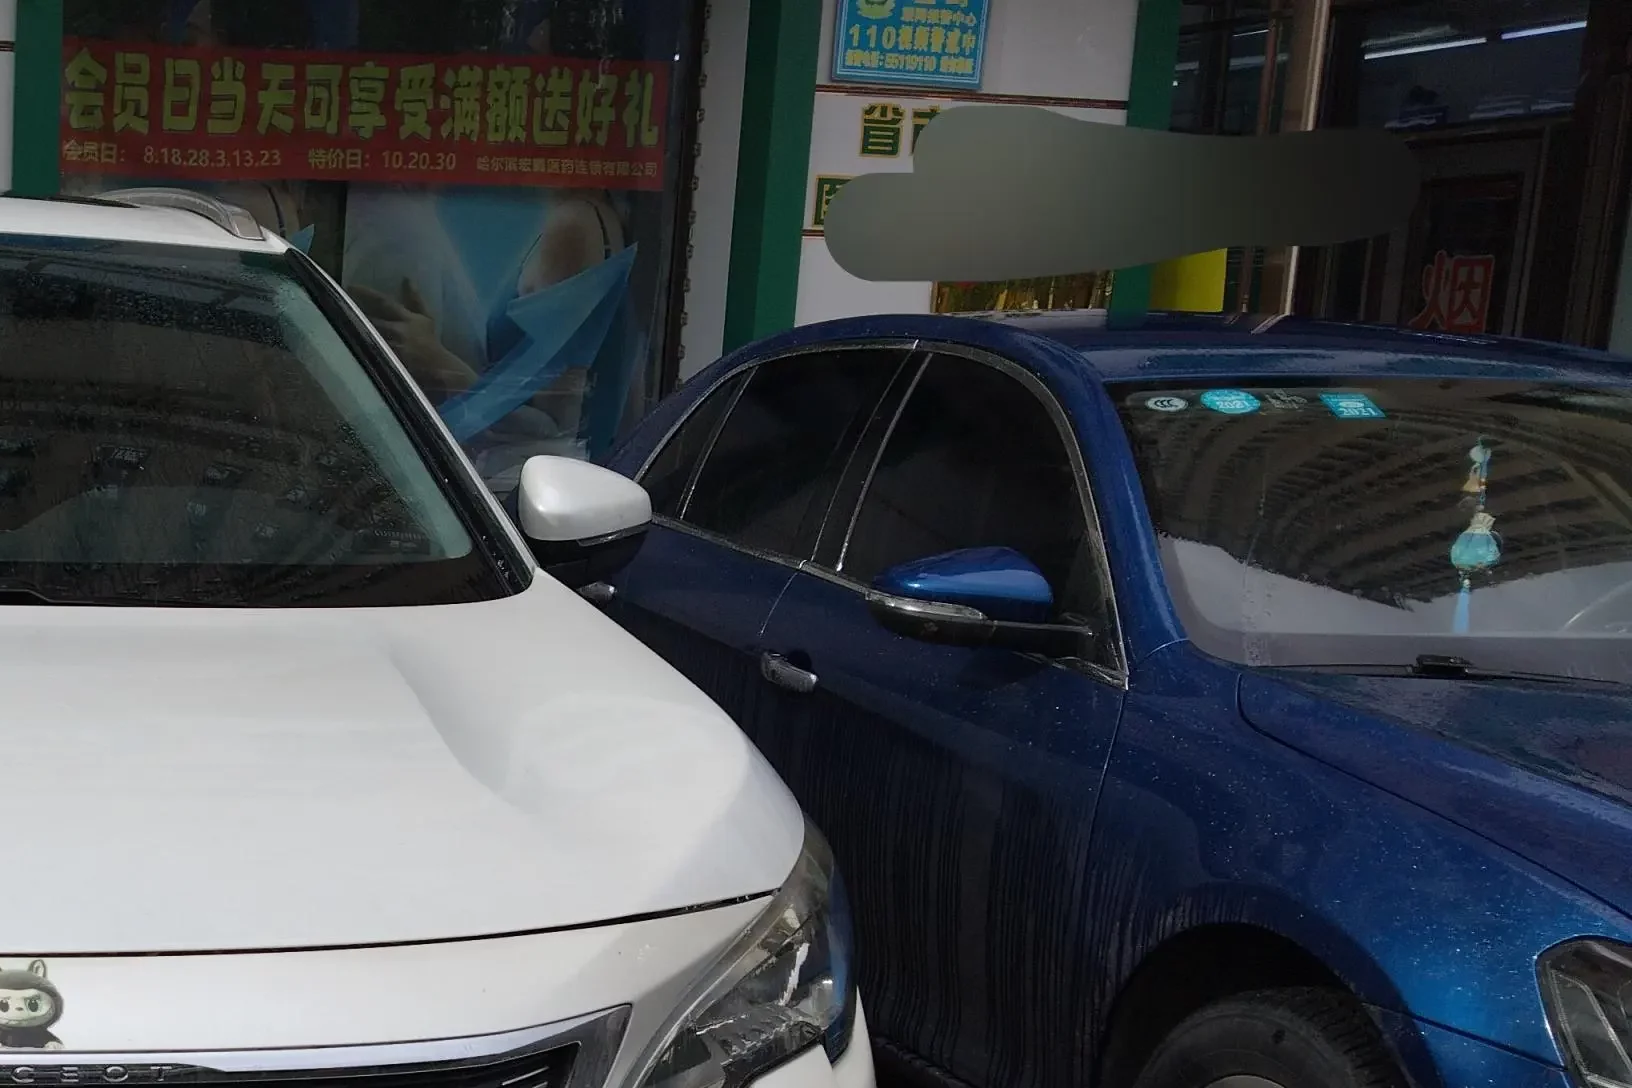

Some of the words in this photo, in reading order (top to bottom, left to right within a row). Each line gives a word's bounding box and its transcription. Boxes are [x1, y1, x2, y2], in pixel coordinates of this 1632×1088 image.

[63, 47, 660, 149] 会员日当天可享受满额送好礼
[143, 146, 282, 168] 8.18.28.3.13.23
[381, 152, 457, 172] 10.20.30
[1409, 250, 1495, 333] 烟
